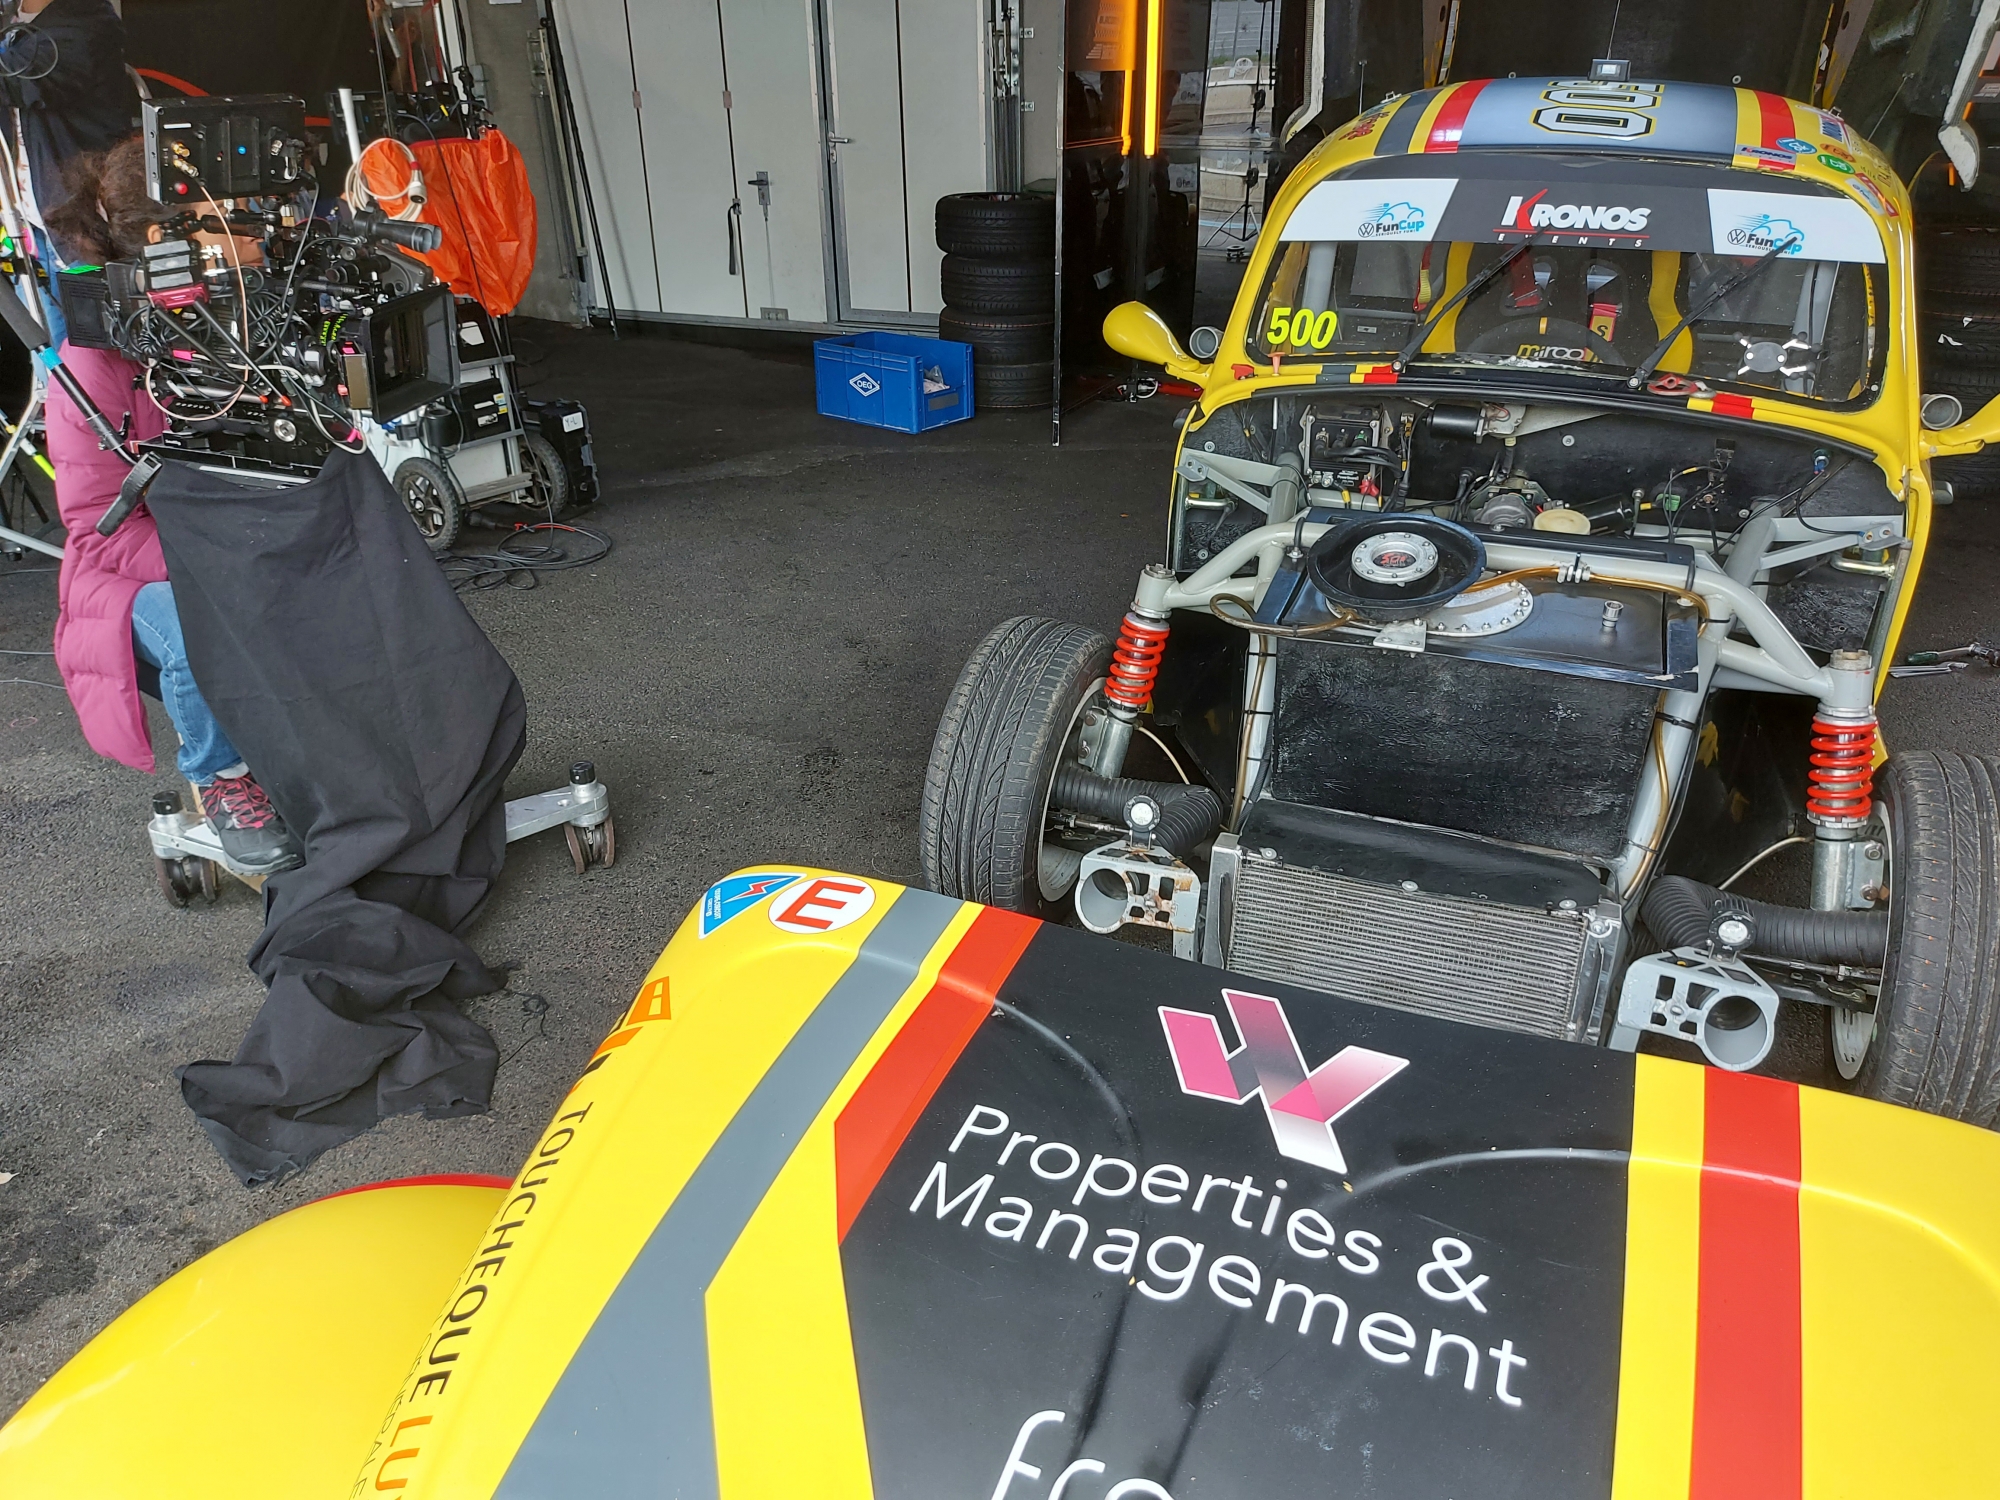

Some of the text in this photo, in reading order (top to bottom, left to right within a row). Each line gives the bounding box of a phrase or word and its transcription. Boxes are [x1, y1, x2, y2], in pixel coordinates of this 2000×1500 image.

[1375, 220, 1424, 233] FunCup
[1501, 188, 1652, 232] KRONOS
[1498, 233, 1643, 248] EENTS
[1266, 307, 1338, 350] 500
[856, 380, 873, 390] OEG
[774, 879, 867, 930] E
[947, 1104, 1490, 1313] Properties &
[409, 1101, 595, 1403] TOUCHEQUE
[908, 1161, 1528, 1407] Management
[374, 1414, 434, 1500] LU
